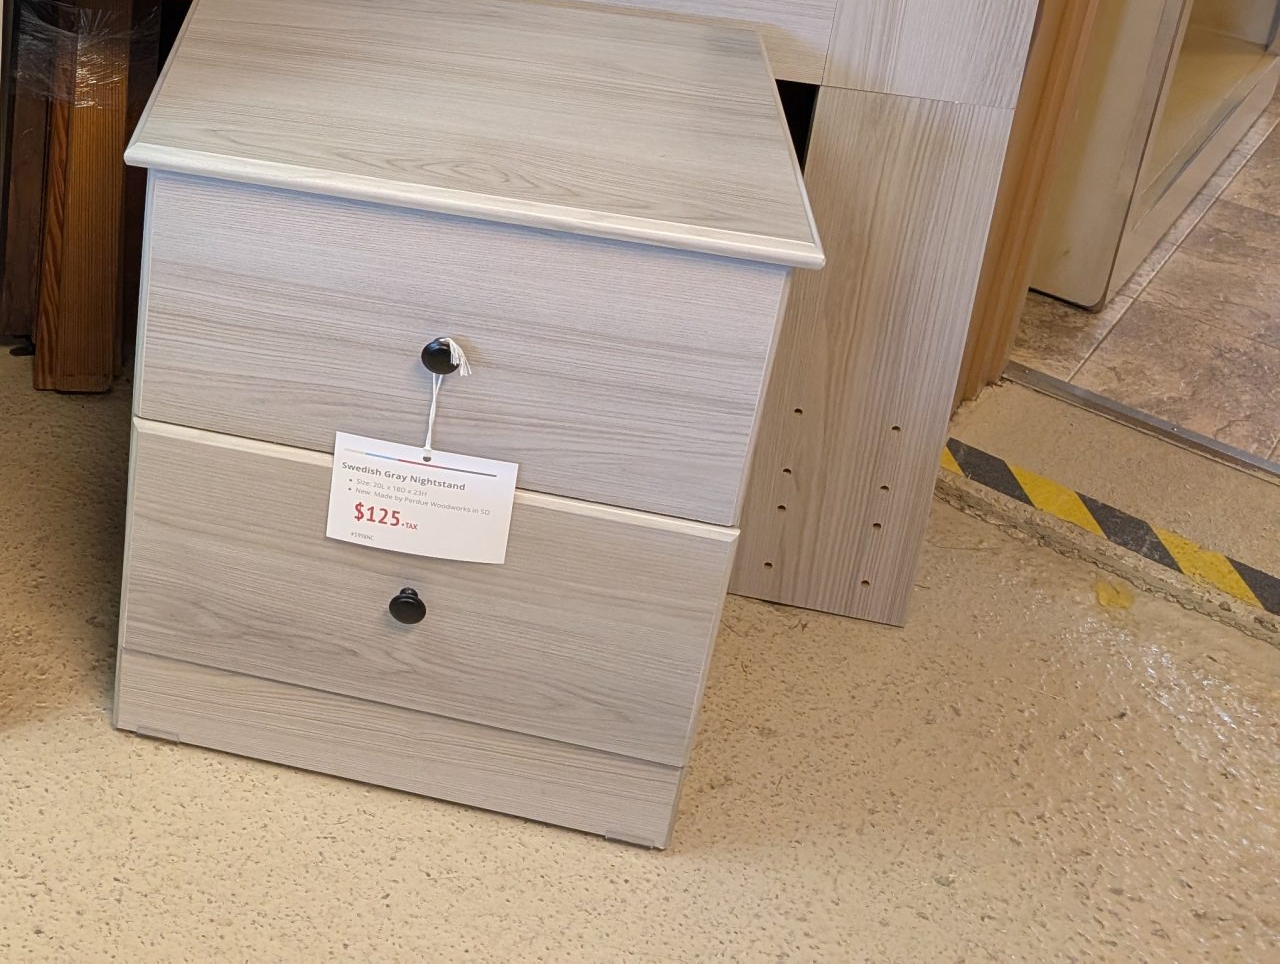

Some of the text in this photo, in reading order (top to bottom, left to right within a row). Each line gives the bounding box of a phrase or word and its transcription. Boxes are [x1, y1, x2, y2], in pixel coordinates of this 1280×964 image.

[342, 461, 465, 491] Swedish Gray Nightstand
[356, 478, 370, 487] Size:
[373, 482, 384, 491] 20L
[354, 502, 401, 527] $125
[374, 491, 392, 501] Made
[394, 495, 403, 504] by
[405, 497, 428, 507] Perdue
[430, 501, 471, 513] Woodworks
[480, 508, 490, 516] SD
